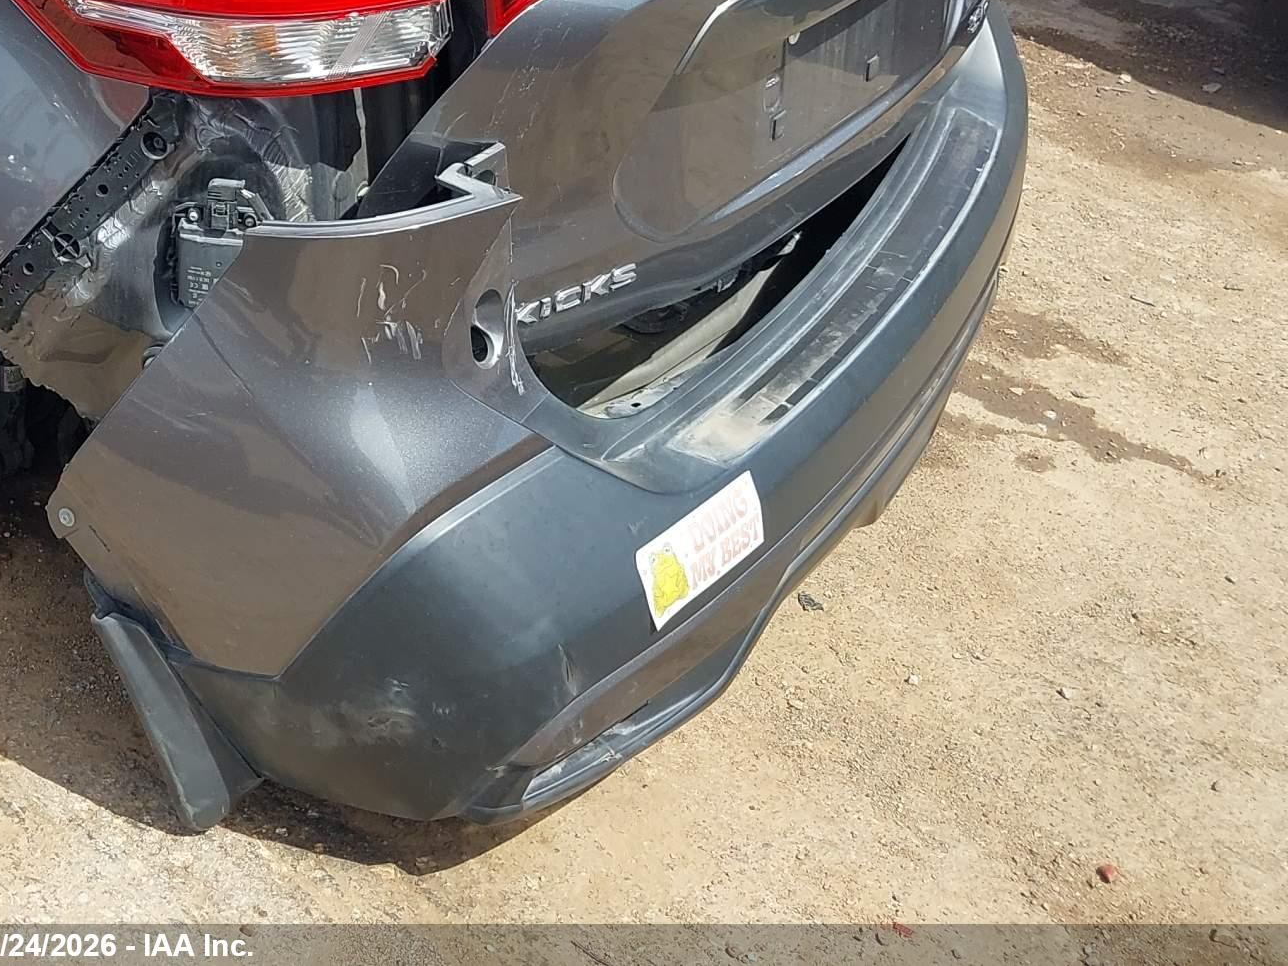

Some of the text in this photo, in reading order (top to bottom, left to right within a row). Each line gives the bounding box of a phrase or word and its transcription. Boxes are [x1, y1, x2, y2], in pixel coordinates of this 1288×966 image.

[515, 263, 637, 324] KICKS
[689, 489, 748, 552] DOING
[720, 513, 760, 567] BEST
